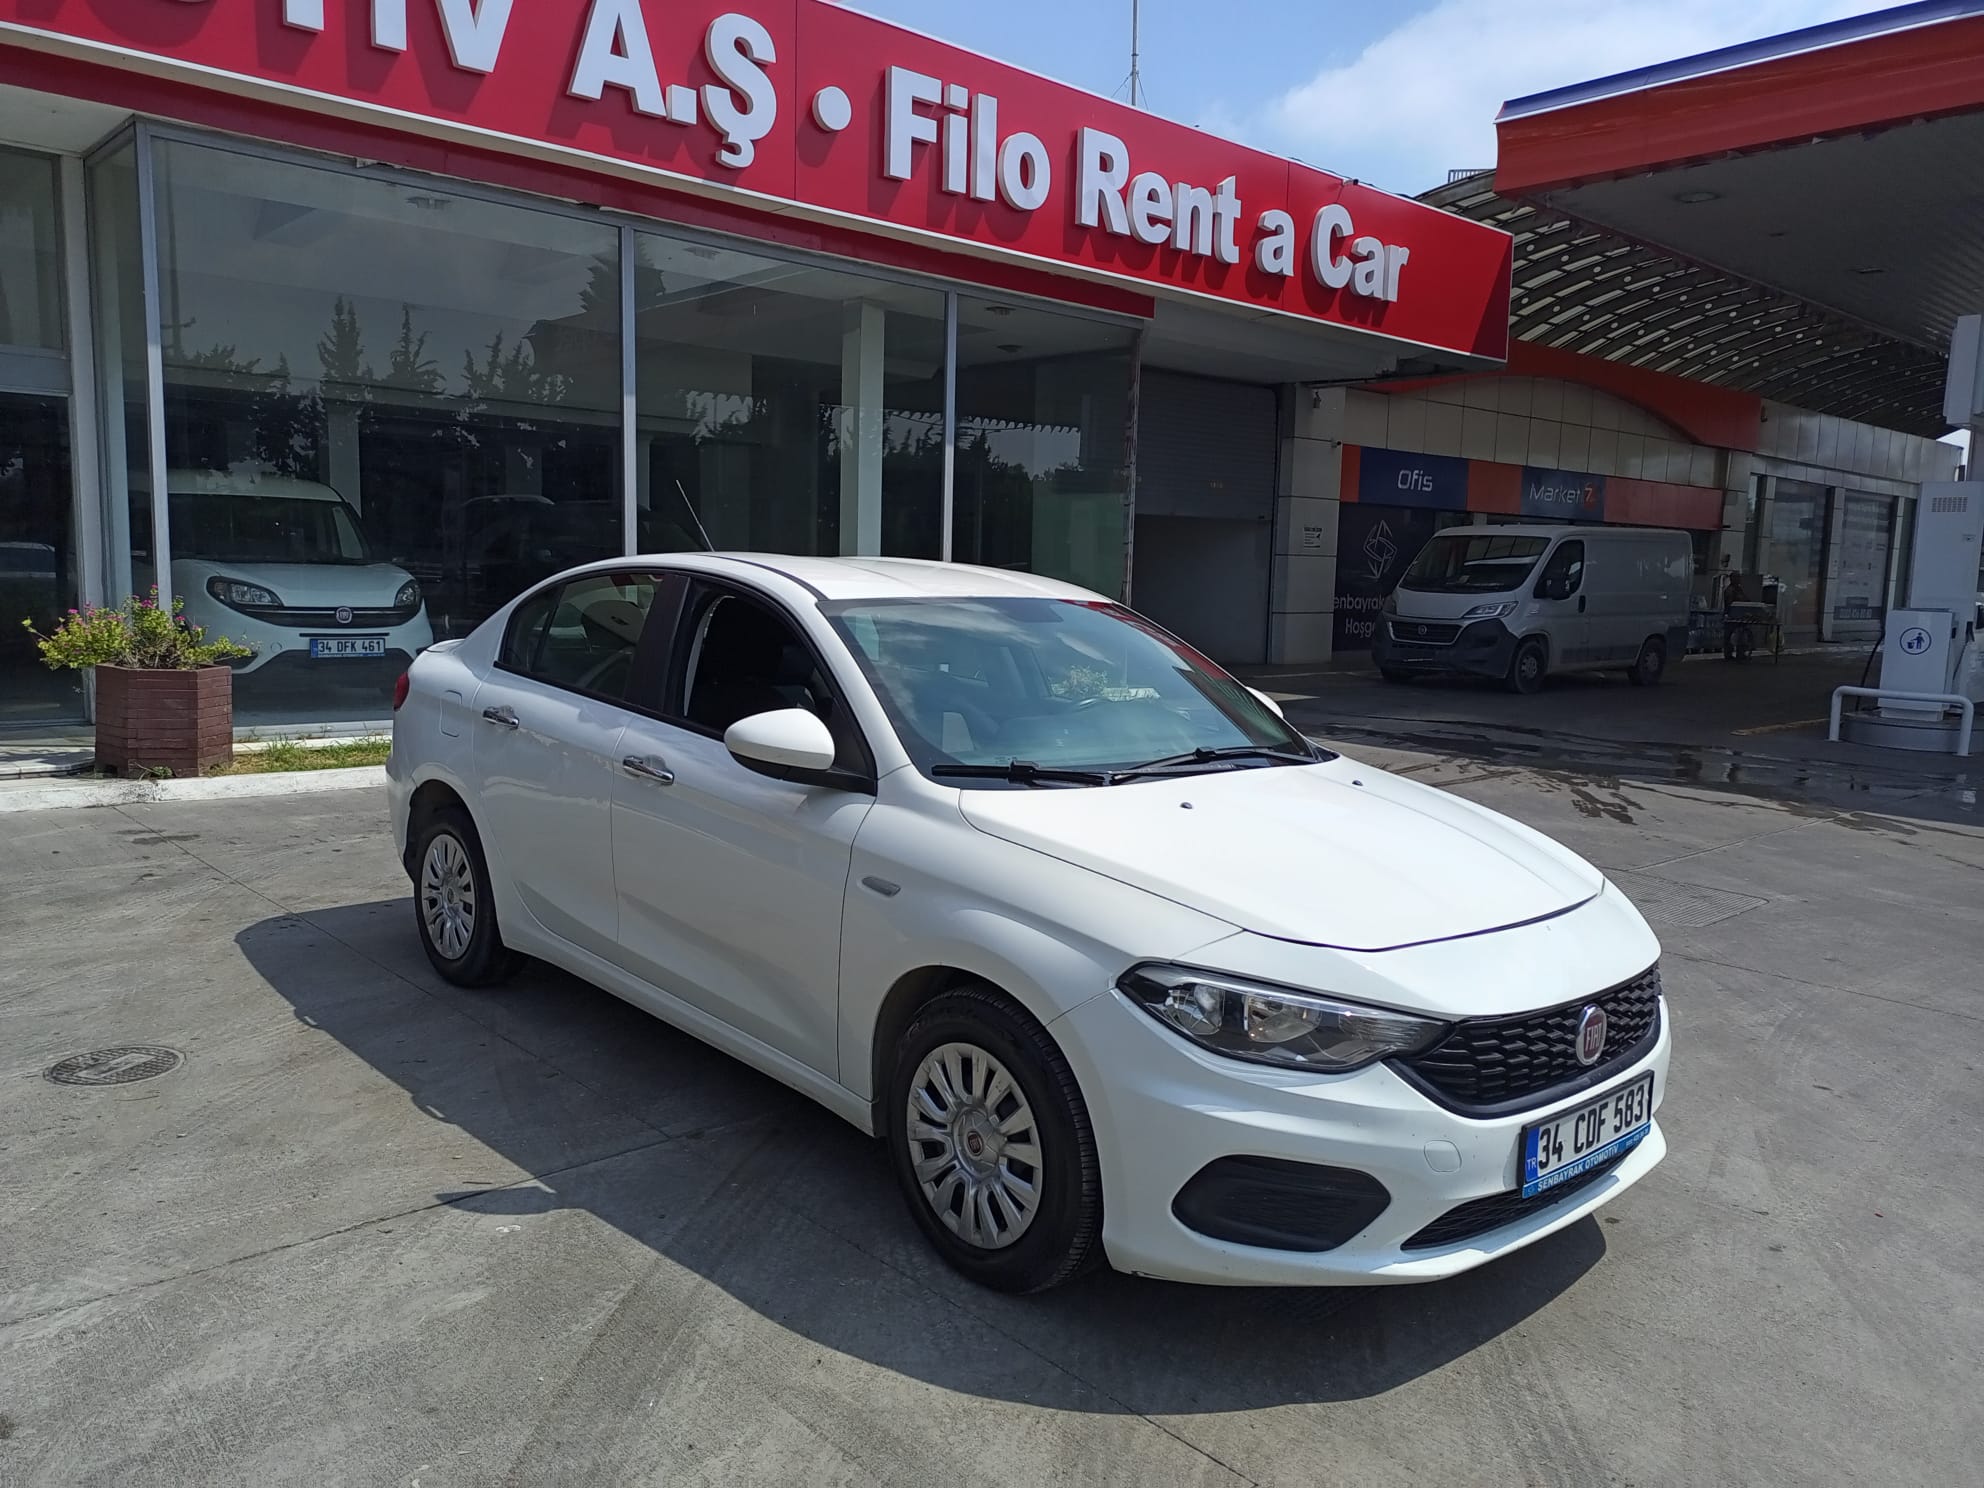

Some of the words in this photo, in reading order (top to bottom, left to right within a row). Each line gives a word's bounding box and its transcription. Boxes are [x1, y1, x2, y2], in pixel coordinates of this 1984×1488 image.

[884, 65, 1051, 211] Filo
[1075, 127, 1242, 265] Rent
[1255, 209, 1295, 277] a
[1312, 203, 1410, 302] Car
[1398, 469, 1433, 492] Ofis
[1529, 483, 1581, 504] Market
[319, 641, 332, 652] 34
[337, 641, 356, 652] DFK
[362, 641, 381, 652] 461
[1586, 1024, 1602, 1052] FIAT
[1538, 1124, 1563, 1169] 34
[1574, 1102, 1608, 1154] CDF
[1614, 1084, 1644, 1133] 583
[1527, 1158, 1537, 1171] TR
